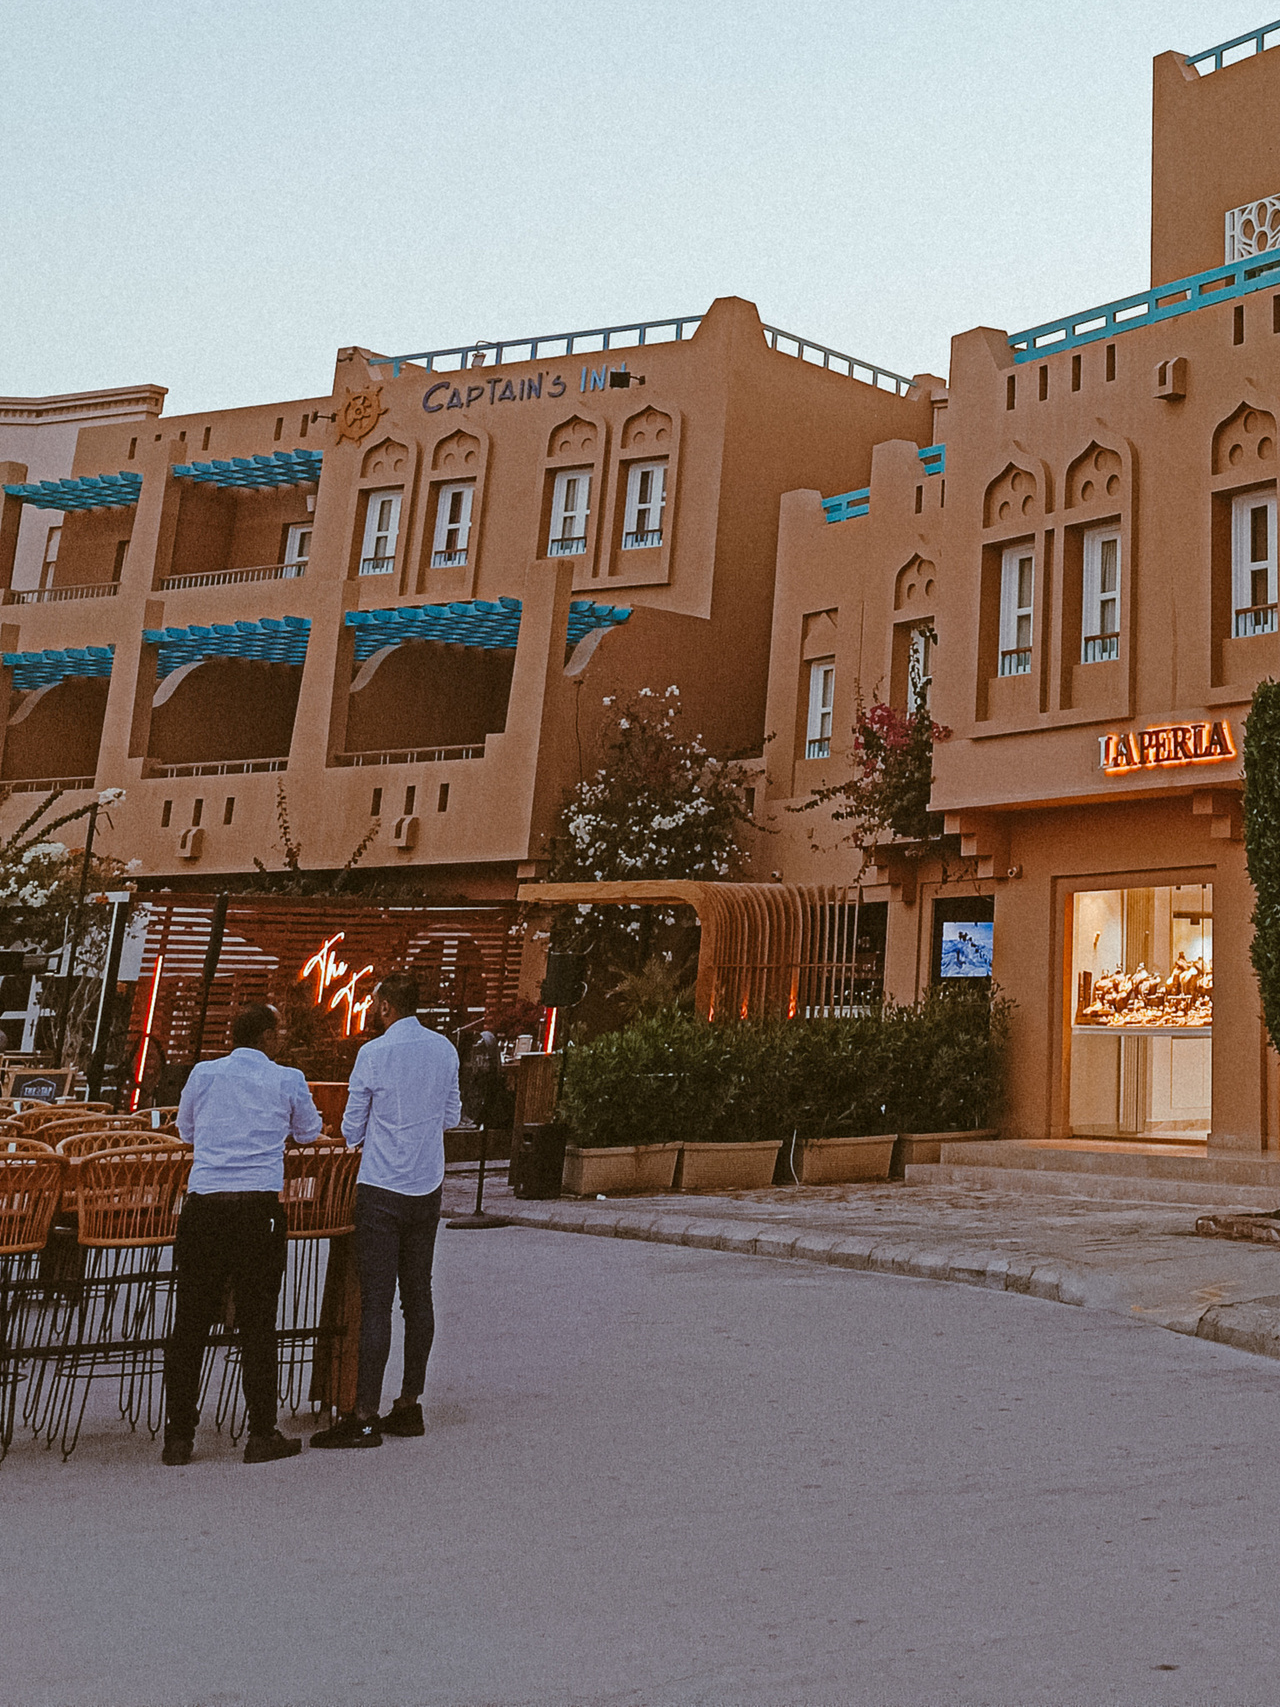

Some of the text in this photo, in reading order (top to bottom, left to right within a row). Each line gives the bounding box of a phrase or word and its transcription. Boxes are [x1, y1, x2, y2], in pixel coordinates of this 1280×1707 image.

[421, 362, 627, 413] CAPTAIN'S IN
[302, 930, 349, 1004] The
